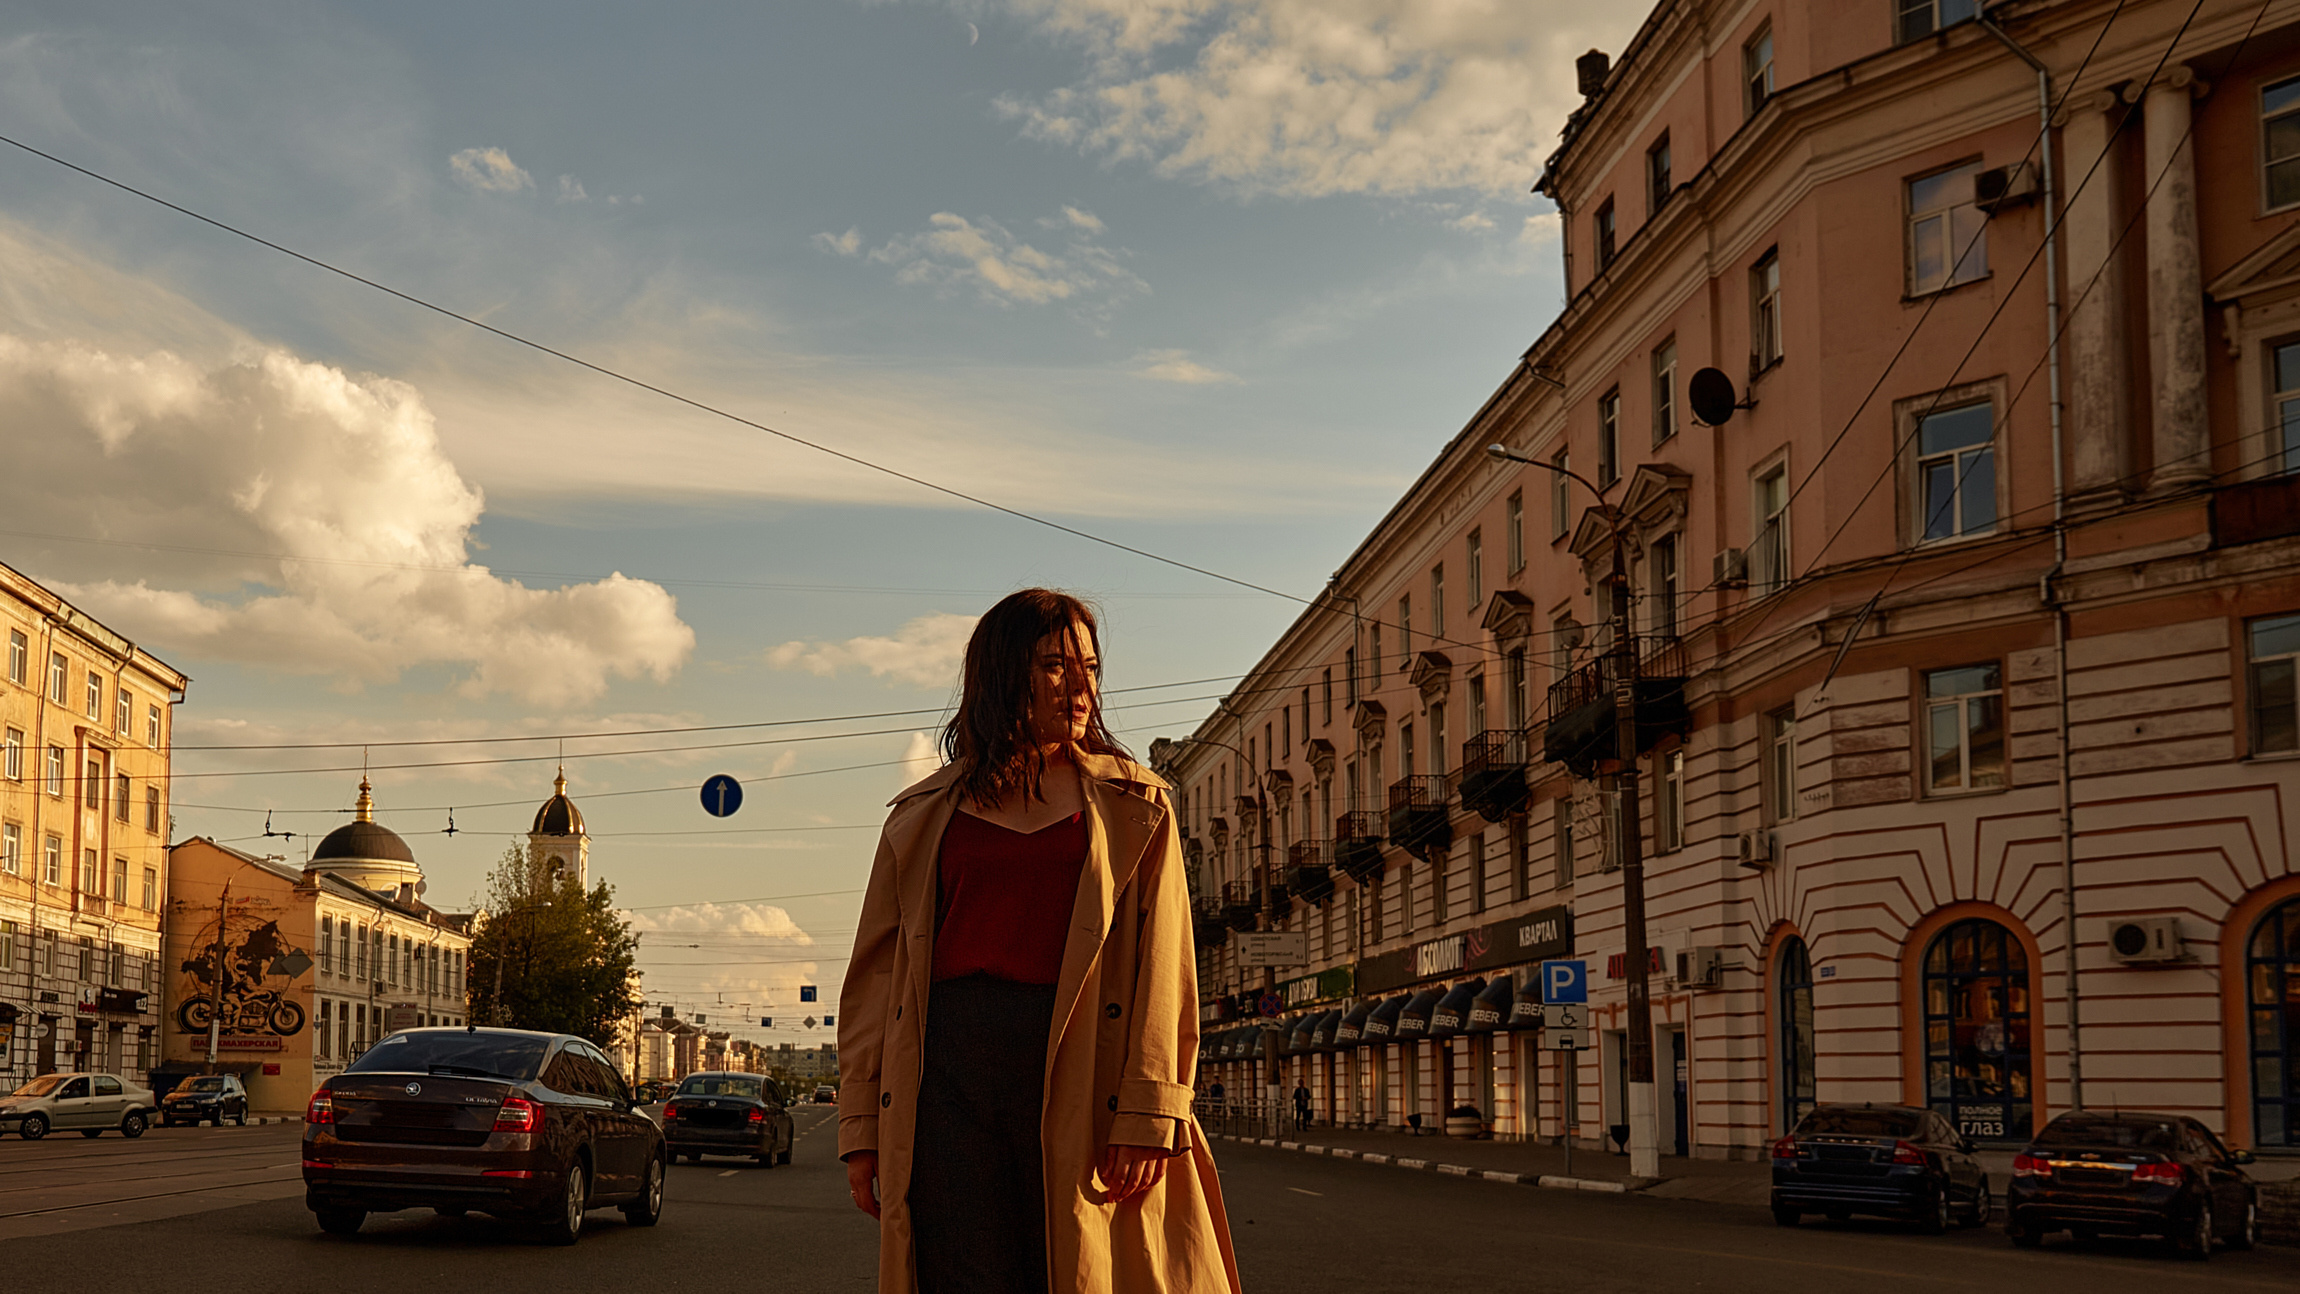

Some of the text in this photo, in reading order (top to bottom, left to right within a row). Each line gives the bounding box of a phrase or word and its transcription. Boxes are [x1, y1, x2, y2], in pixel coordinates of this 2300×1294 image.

[1416, 919, 1558, 977] АБСОЛЮТ КВАРТАЛ
[1606, 946, 1667, 979] АПА
[1550, 965, 1575, 999] P
[193, 1040, 279, 1048] ПАКМАХЕРСКАЯ
[465, 1096, 499, 1104] OCTAVIA
[1959, 1106, 2003, 1115] полное
[1960, 1122, 2004, 1136] глаз
